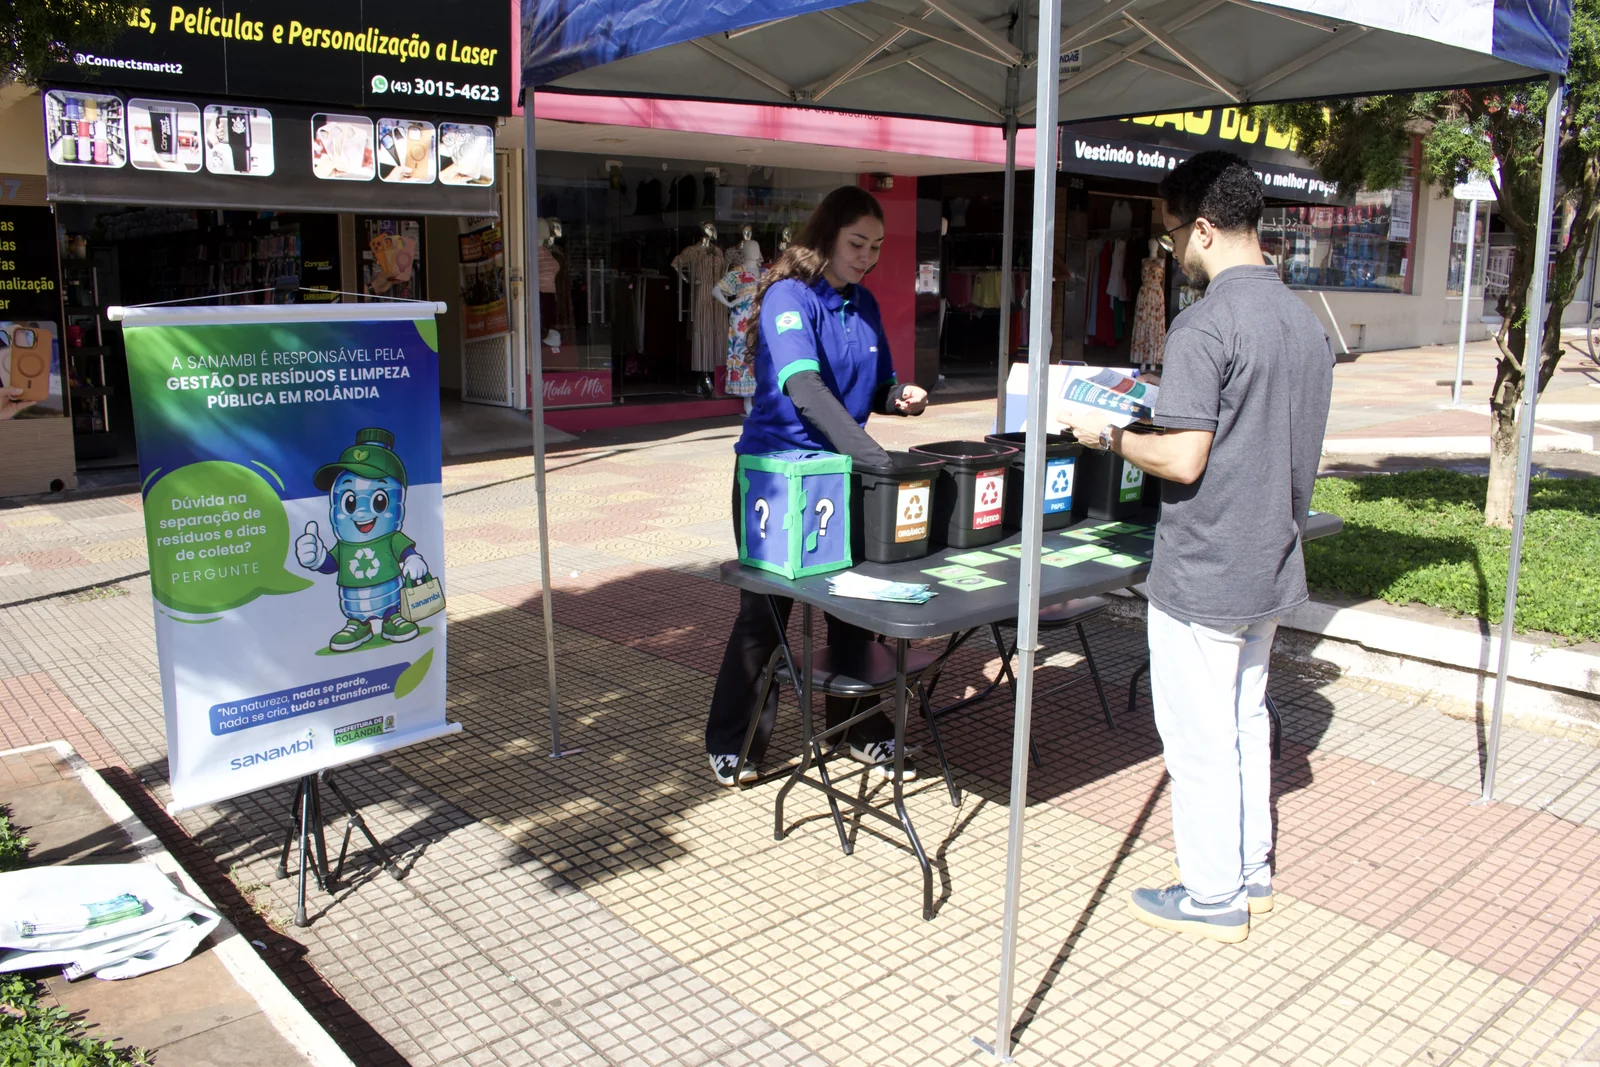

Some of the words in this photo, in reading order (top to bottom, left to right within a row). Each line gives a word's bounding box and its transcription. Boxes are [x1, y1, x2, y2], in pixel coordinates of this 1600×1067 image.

[170, 6, 264, 41] Películas
[272, 24, 284, 44] e
[288, 21, 430, 63] Personalização
[436, 42, 447, 61] a
[450, 40, 498, 66] Laser
[73, 53, 183, 75] @Connectsmartt2
[390, 79, 412, 95] (43)
[414, 78, 500, 102] 3015-4623
[1074, 140, 1133, 164] Vestindo
[1136, 150, 1166, 168] toda
[1167, 155, 1176, 170] a
[1264, 173, 1272, 185] o
[1273, 172, 1308, 190] melhor
[171, 356, 182, 370] A
[188, 353, 256, 369] SANAMBI
[261, 350, 268, 366] É
[273, 347, 371, 365] RESPONSÁVEL
[375, 348, 405, 361] PELA
[166, 371, 235, 390] GESTÃO
[238, 373, 258, 387] DE
[261, 368, 336, 386] RESÍDUOS
[340, 369, 348, 382] E
[350, 366, 411, 381] LIMPEZA
[574, 376, 606, 397] Mix
[207, 390, 276, 408] PÚBLICA
[279, 391, 301, 404] EM
[304, 385, 380, 402] ROLÂNDIA
[171, 495, 225, 511] Dúvida
[228, 494, 247, 505] na
[1051, 502, 1066, 511] PAPEL
[159, 510, 240, 530] separação
[243, 508, 261, 520] de
[976, 514, 1000, 525] PLÁSTICO
[157, 531, 221, 547] resíduos
[224, 528, 233, 539] e
[236, 524, 267, 537] dias
[175, 549, 195, 561] de
[198, 541, 252, 559] coleta?
[171, 562, 260, 584] PERGUNTE
[411, 591, 440, 609] sanambi
[240, 695, 291, 713] natureza,
[292, 687, 321, 701] nada
[323, 683, 334, 694] se
[336, 676, 369, 693] perde,
[219, 715, 249, 730] nada
[252, 712, 264, 723] se
[267, 707, 290, 720] cria,
[290, 700, 316, 713] tudo
[318, 697, 330, 707] se
[331, 682, 391, 703] transforma.
[334, 721, 373, 735] PREFEITURA
[373, 717, 383, 725] DE
[335, 723, 383, 745] ROLÂNDIA
